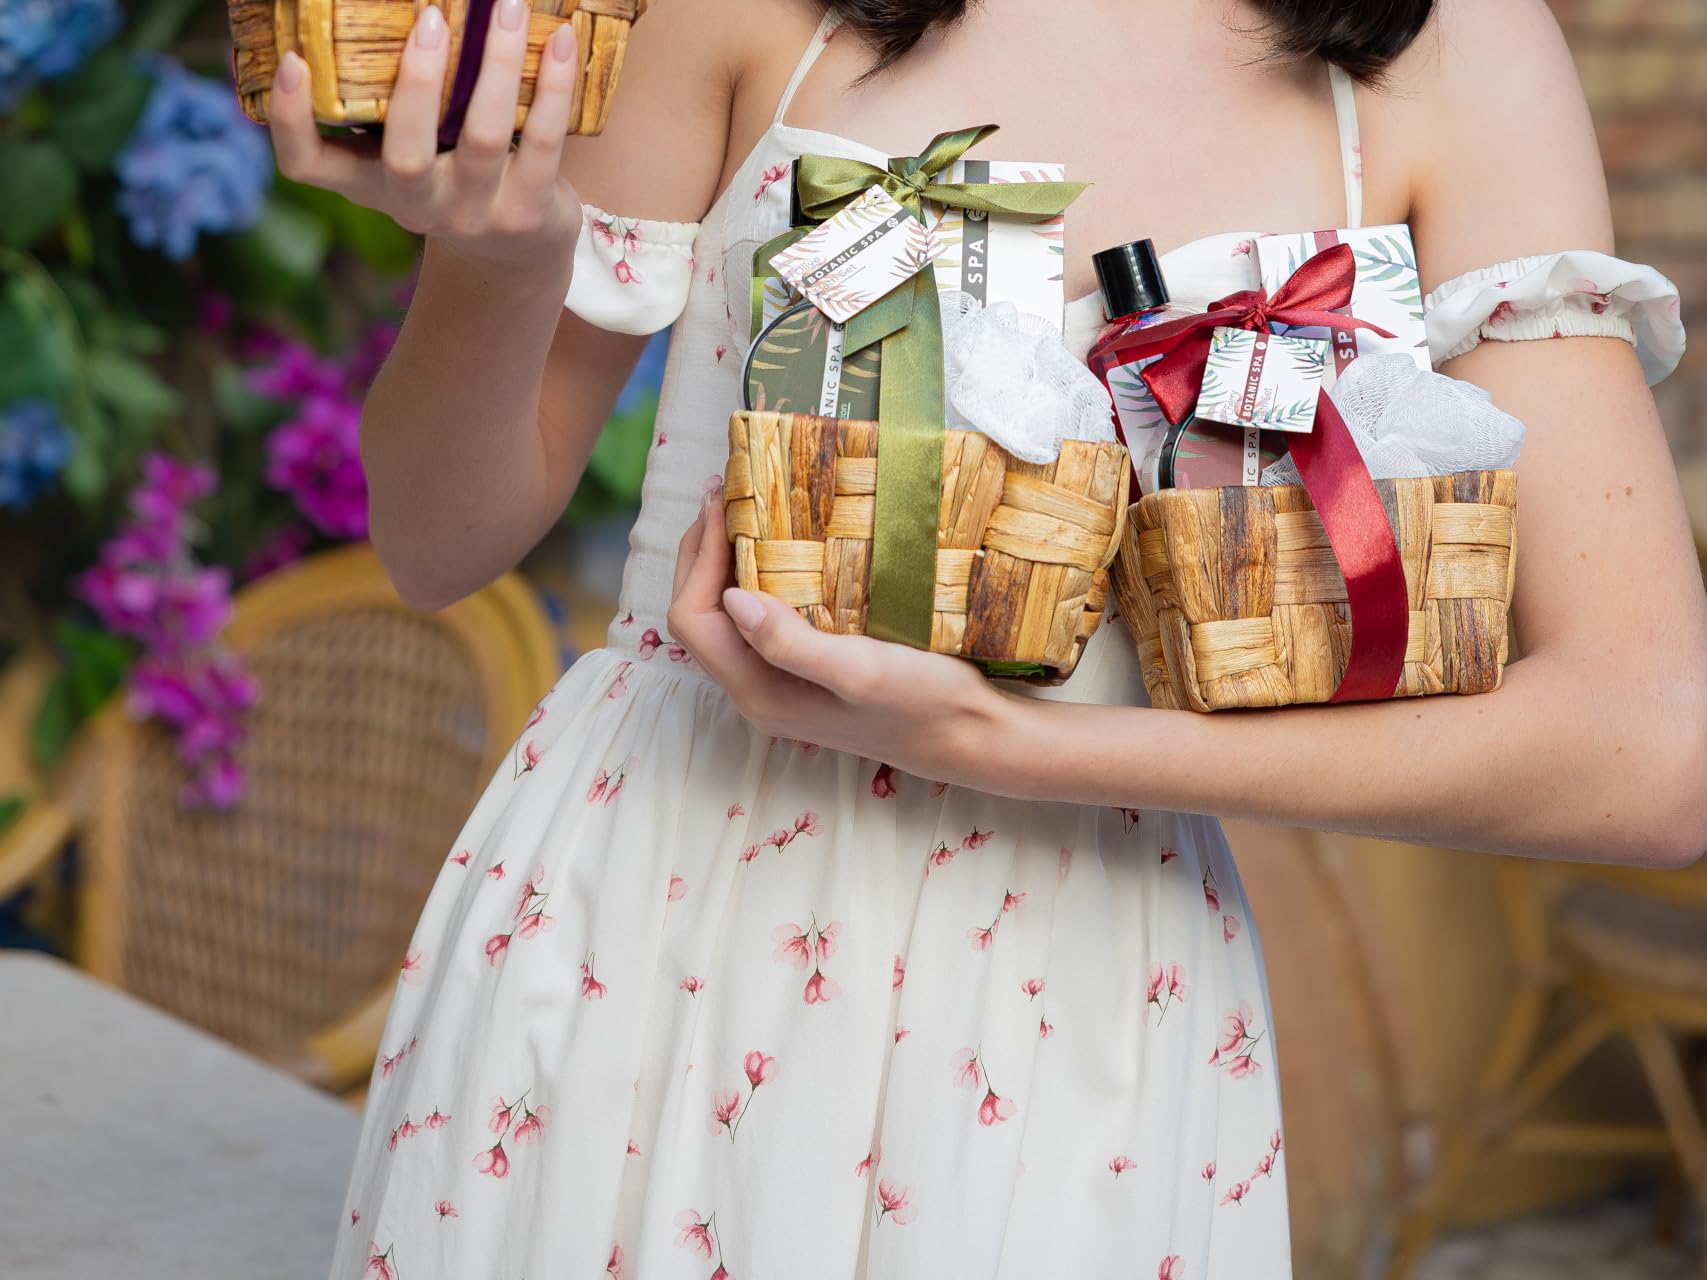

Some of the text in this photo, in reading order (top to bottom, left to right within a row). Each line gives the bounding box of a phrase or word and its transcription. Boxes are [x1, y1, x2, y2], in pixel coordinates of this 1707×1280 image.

[795, 255, 821, 276] Olive
[806, 229, 883, 284] BOTANIC SPA
[841, 262, 858, 279] Set
[967, 238, 985, 284] SPA
[1337, 331, 1355, 359] SP
[823, 345, 841, 417] ANIC SPA
[1242, 355, 1263, 418] BOTANIC SPA
[1247, 431, 1257, 459] SPA
